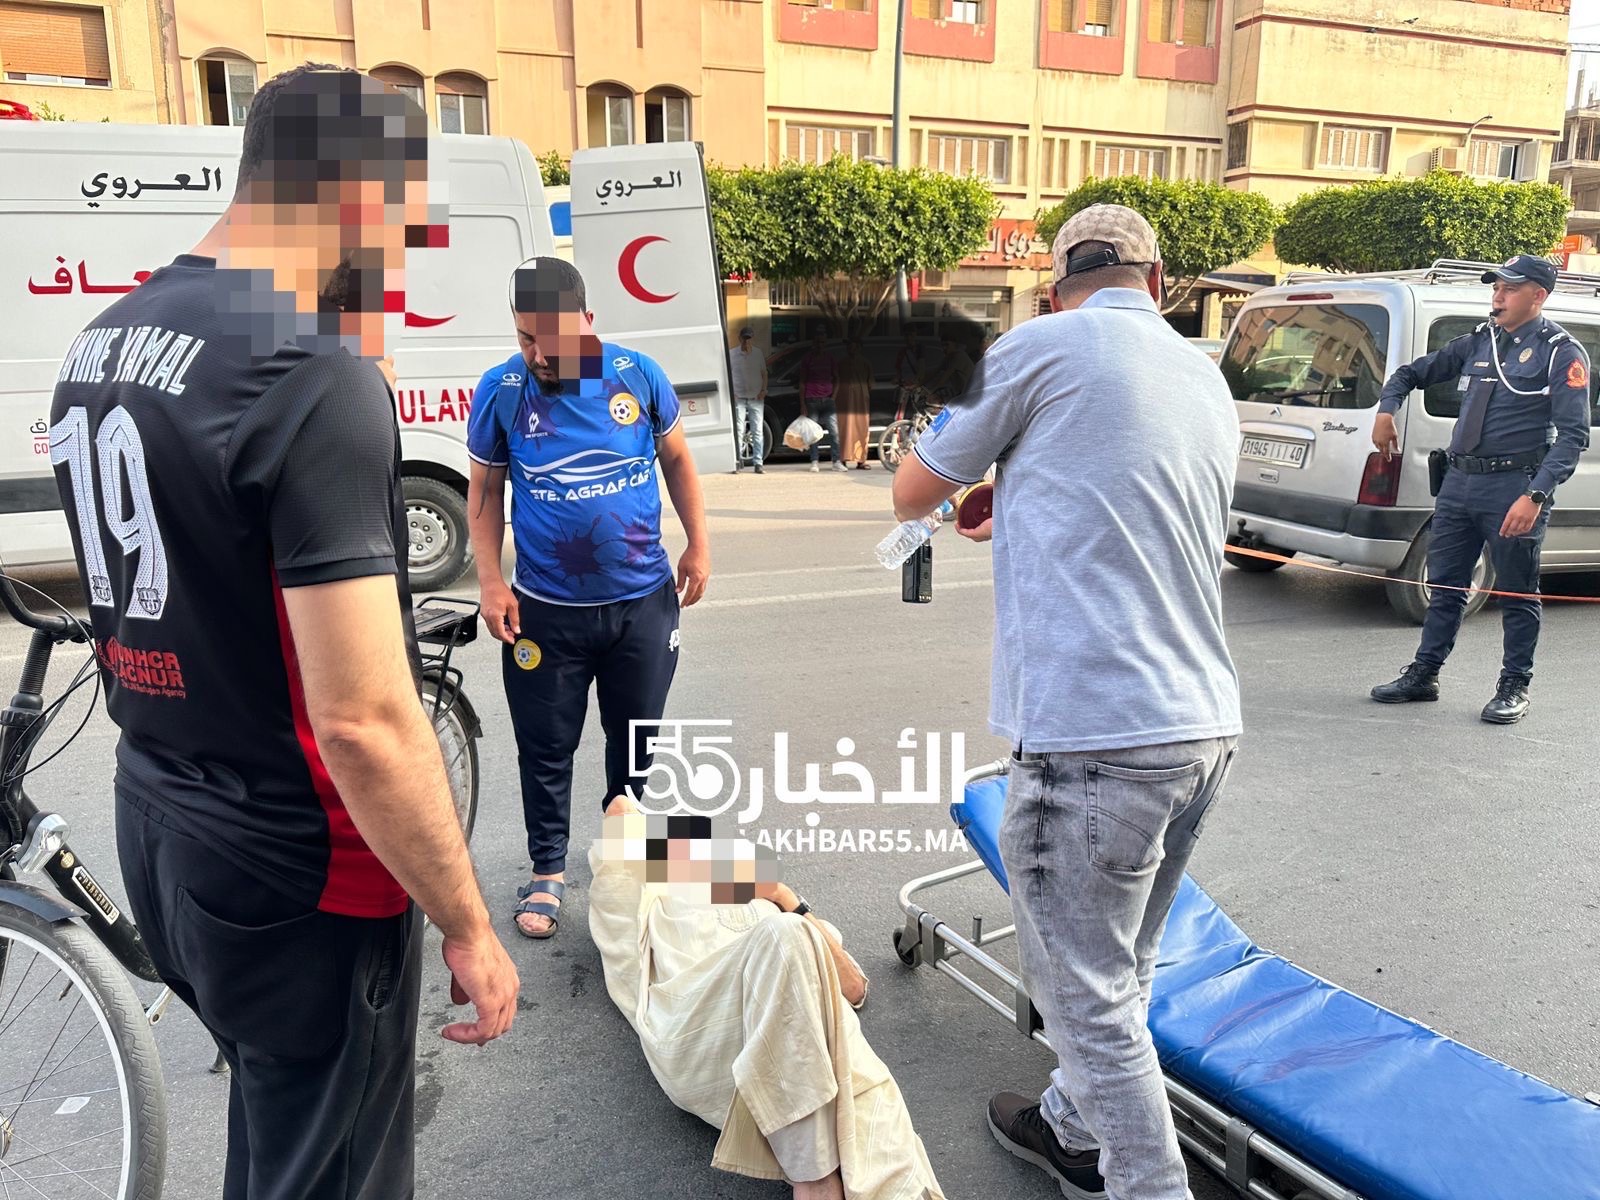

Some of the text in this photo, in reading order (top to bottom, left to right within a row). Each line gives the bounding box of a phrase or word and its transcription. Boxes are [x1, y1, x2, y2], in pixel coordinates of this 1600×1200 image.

[81, 167, 222, 208] العروي
[595, 170, 682, 206] العروي
[28, 256, 152, 294] عاف
[59, 327, 205, 395] AMINE YAMAL
[398, 389, 474, 424] ULAN
[1322, 421, 1358, 434] Berlingo
[1244, 440, 1268, 456] 31945
[1290, 446, 1303, 461] 40
[565, 478, 627, 501] AGRAF
[49, 405, 168, 620] 19
[117, 645, 181, 671] UNHCR
[119, 662, 185, 688] ACNUR
